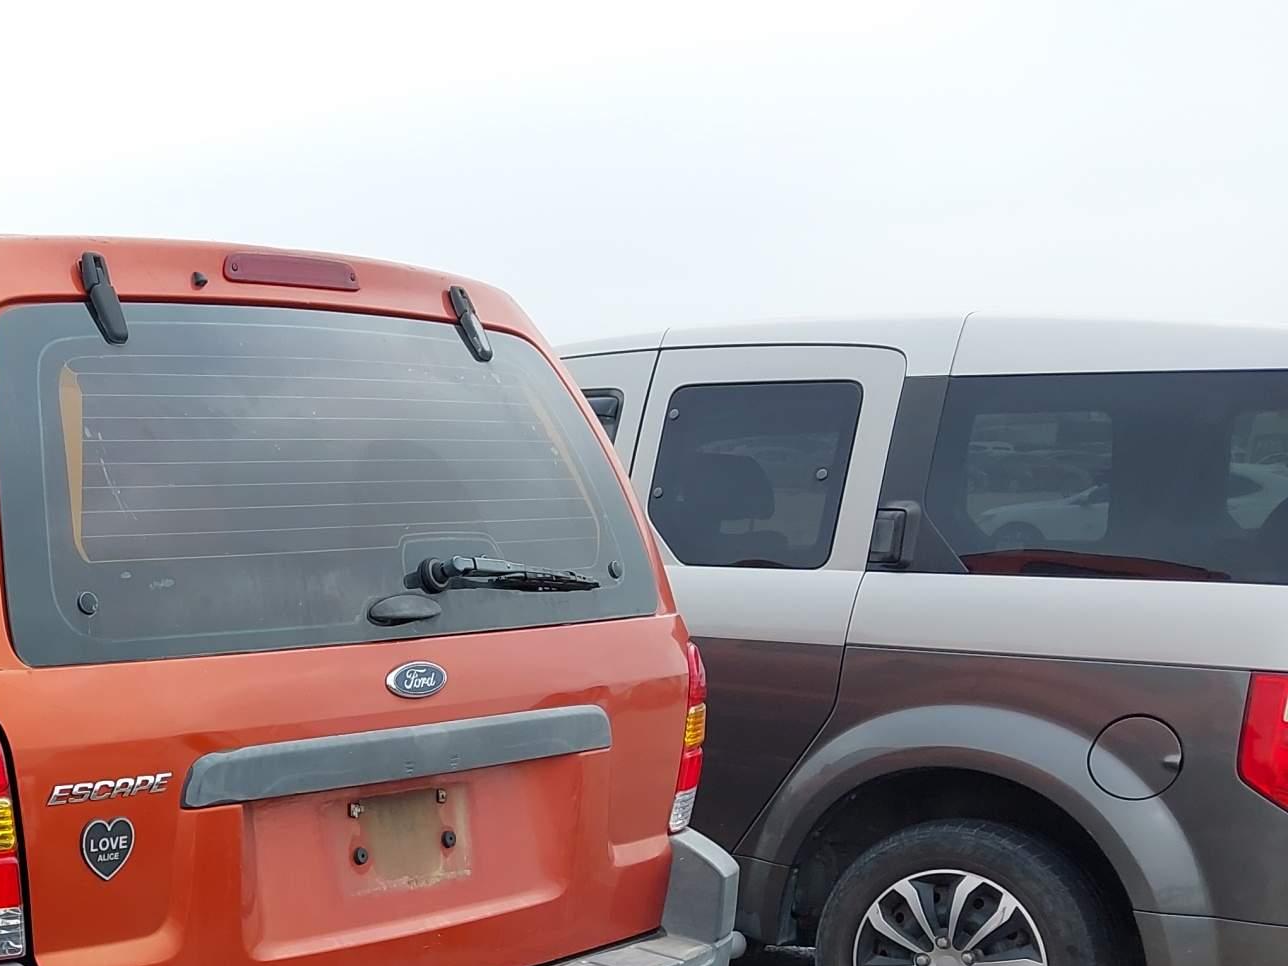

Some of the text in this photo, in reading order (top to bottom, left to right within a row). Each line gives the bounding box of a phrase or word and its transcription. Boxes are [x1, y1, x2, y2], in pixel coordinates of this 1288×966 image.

[403, 667, 436, 690] Ford
[46, 772, 173, 806] ESCAPE
[89, 835, 129, 853] LOVE
[96, 852, 120, 863] ALICE
